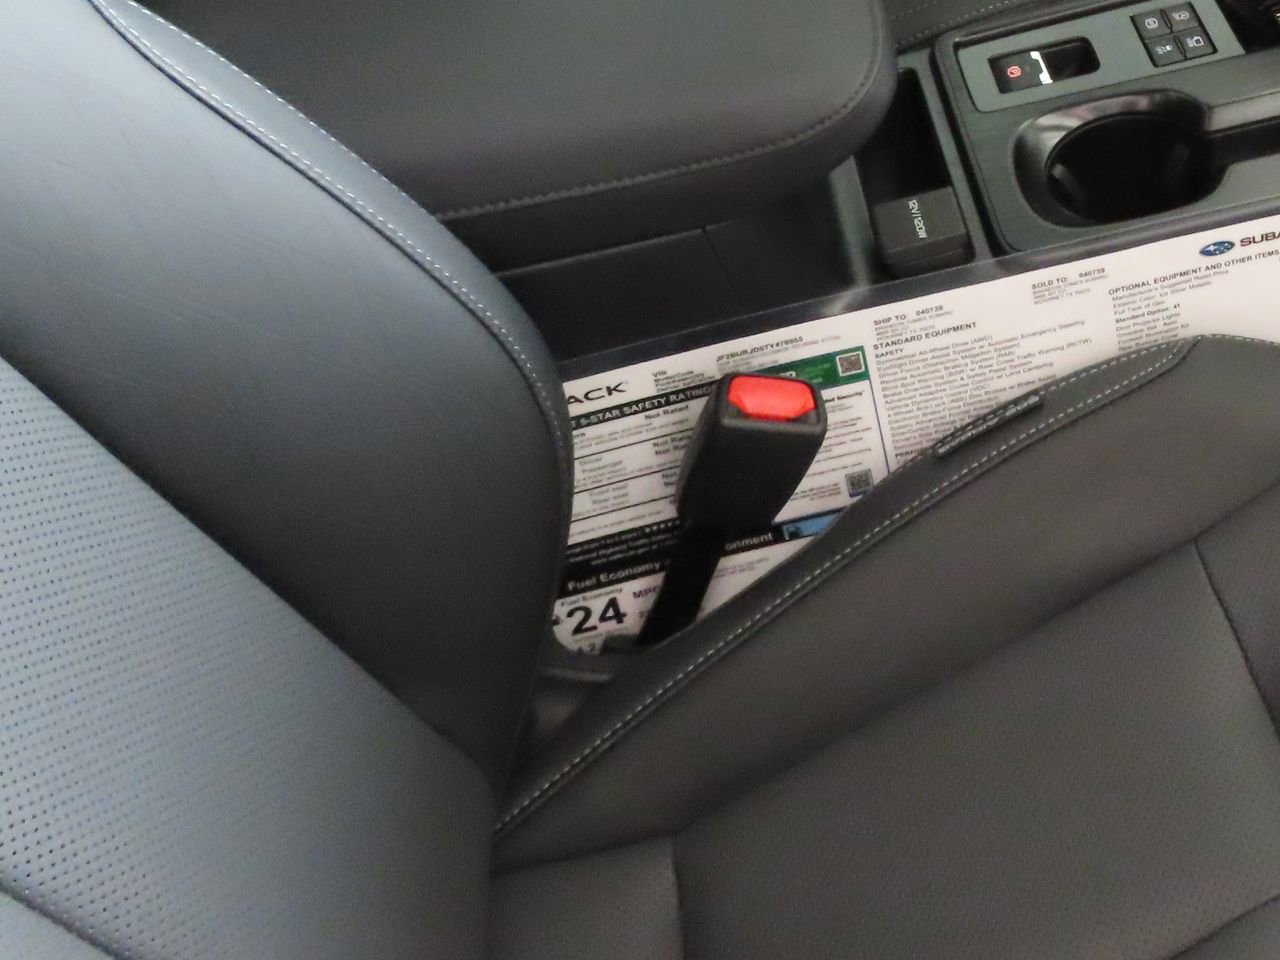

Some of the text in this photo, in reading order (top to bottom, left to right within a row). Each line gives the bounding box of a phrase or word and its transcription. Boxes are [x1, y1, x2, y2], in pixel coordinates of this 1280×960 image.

[1203, 262, 1222, 273] AND
[1224, 255, 1252, 268] OTHER
[1254, 248, 1279, 261] ITEMS
[567, 577, 597, 591] Fuel
[600, 561, 662, 584] Economy
[566, 596, 627, 637] 24
